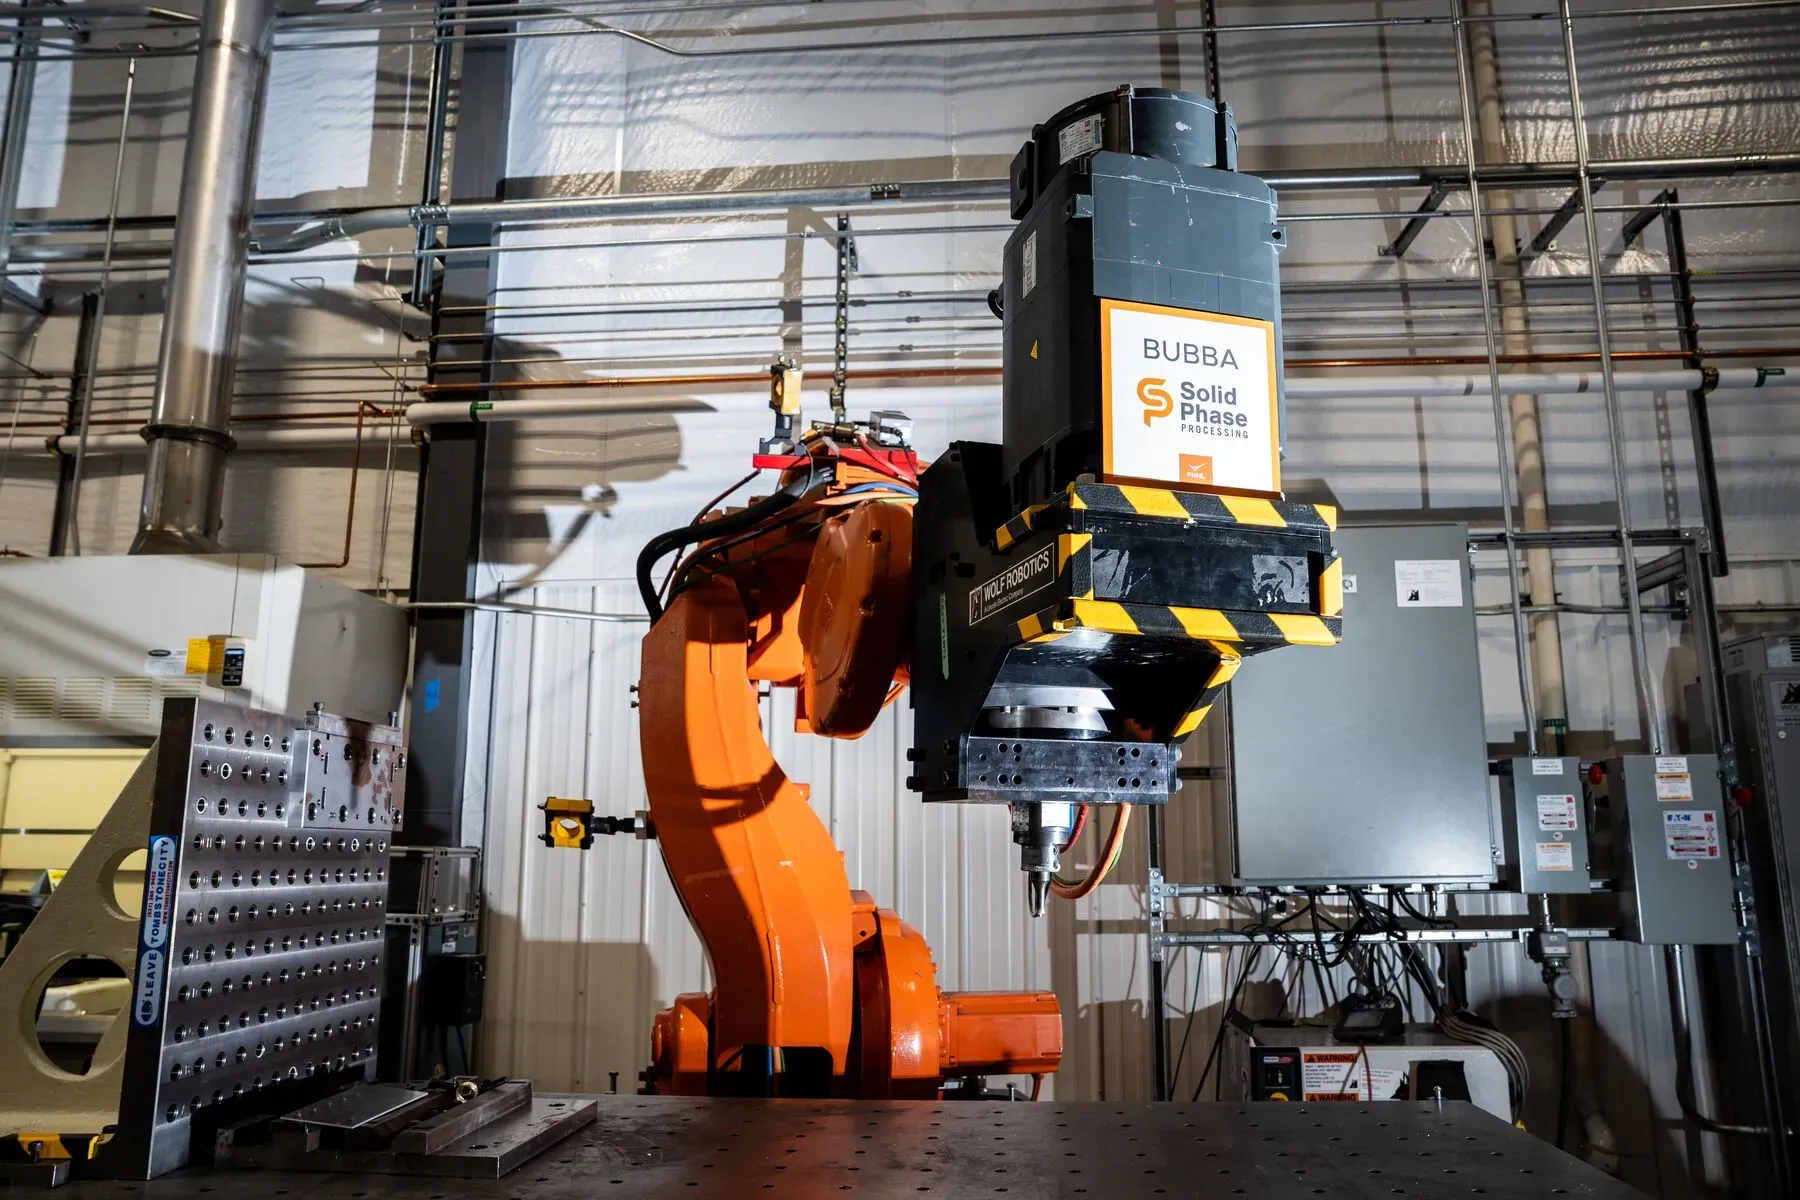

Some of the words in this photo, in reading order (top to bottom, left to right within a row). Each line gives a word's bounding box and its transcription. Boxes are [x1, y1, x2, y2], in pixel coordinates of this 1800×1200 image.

[1143, 338, 1239, 370] BUBBA
[1180, 381, 1237, 405] Solid
[1180, 402, 1248, 427] Phase
[1181, 424, 1249, 439] PROCESSING
[984, 576, 1005, 602] WOLF
[1006, 550, 1050, 590] ROBOTICS
[145, 952, 157, 997] LEAVE
[151, 840, 168, 944] TOMBSTONECITY
[1317, 1054, 1356, 1063] WARNING
[1319, 1093, 1356, 1101] WARNG
